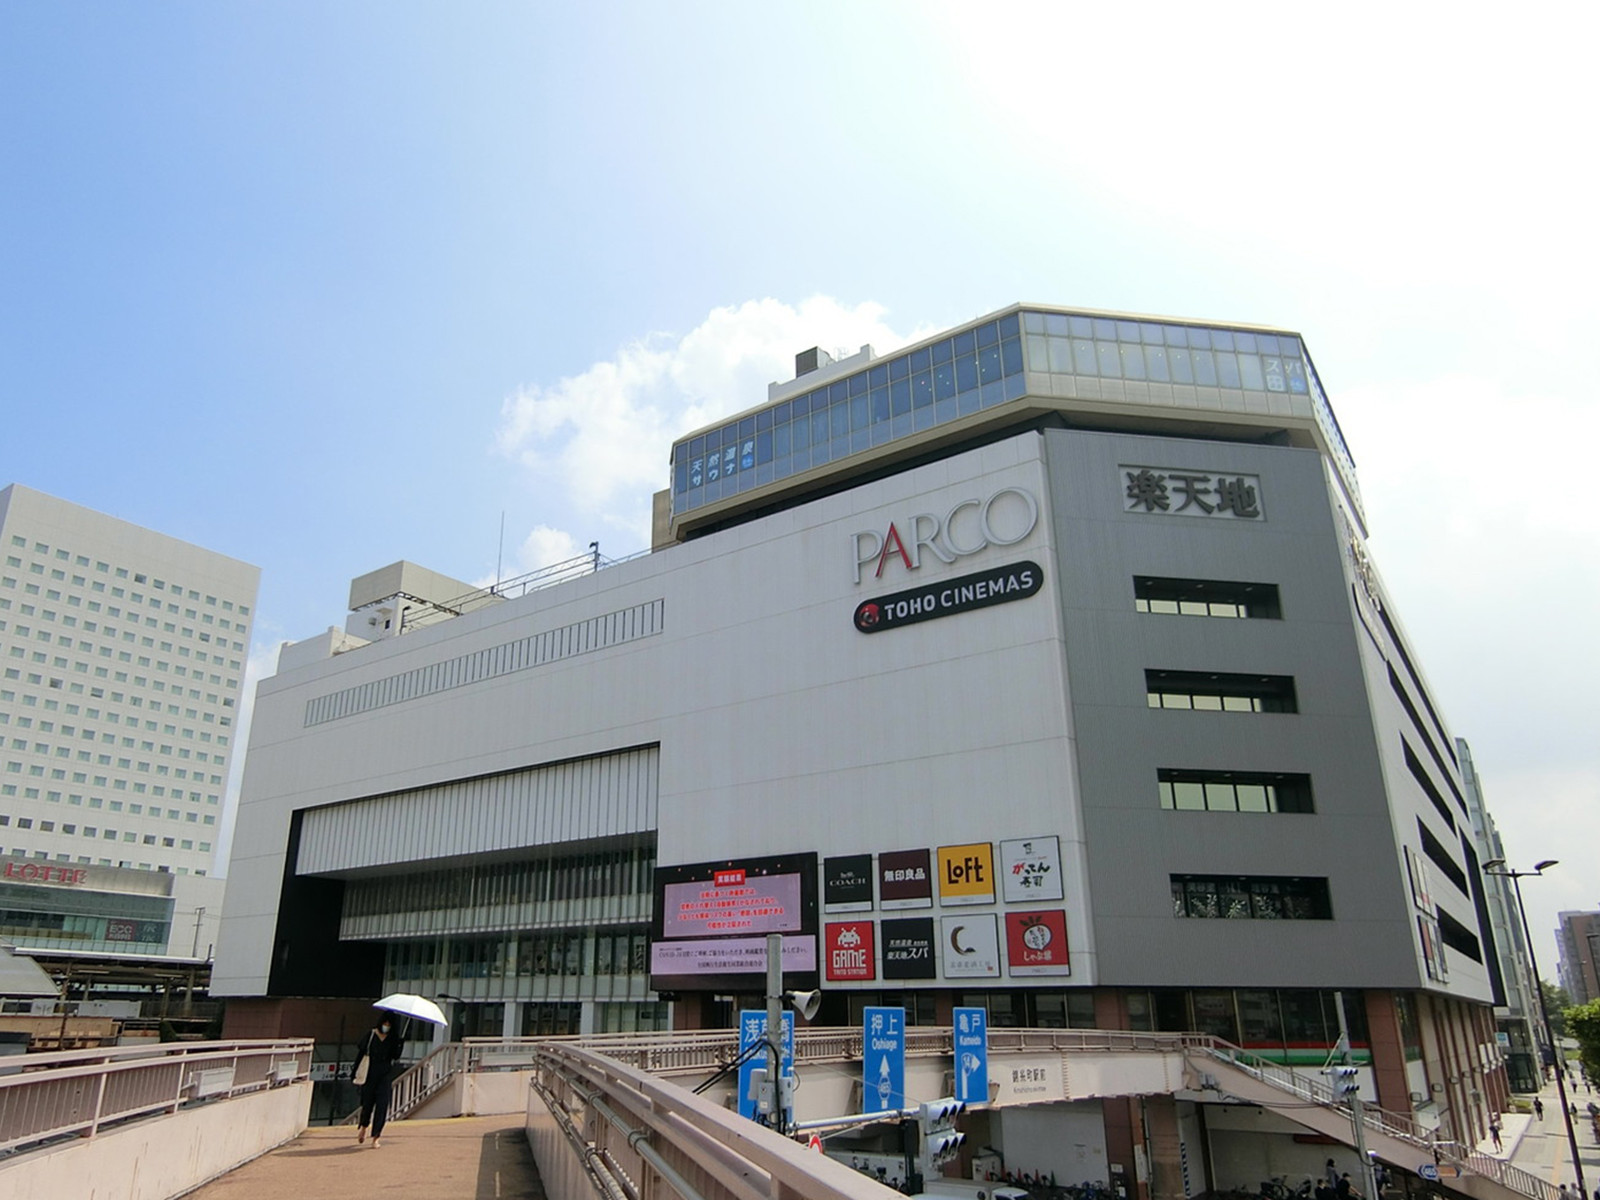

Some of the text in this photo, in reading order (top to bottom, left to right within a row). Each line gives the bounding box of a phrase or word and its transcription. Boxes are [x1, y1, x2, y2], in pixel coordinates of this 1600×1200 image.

[1126, 470, 1260, 518] 楽天地
[851, 486, 1038, 584] PARCO
[884, 570, 1034, 621] TOHO CINEMAS
[4, 862, 87, 884] LOTTE
[829, 877, 866, 887] COACH
[884, 867, 926, 882] 無印良品
[832, 949, 867, 968] GAME
[871, 1014, 898, 1035] 押上
[959, 1013, 981, 1033] 亀戸
[871, 1037, 897, 1051] Oshiage
[959, 1036, 982, 1046] Kameido
